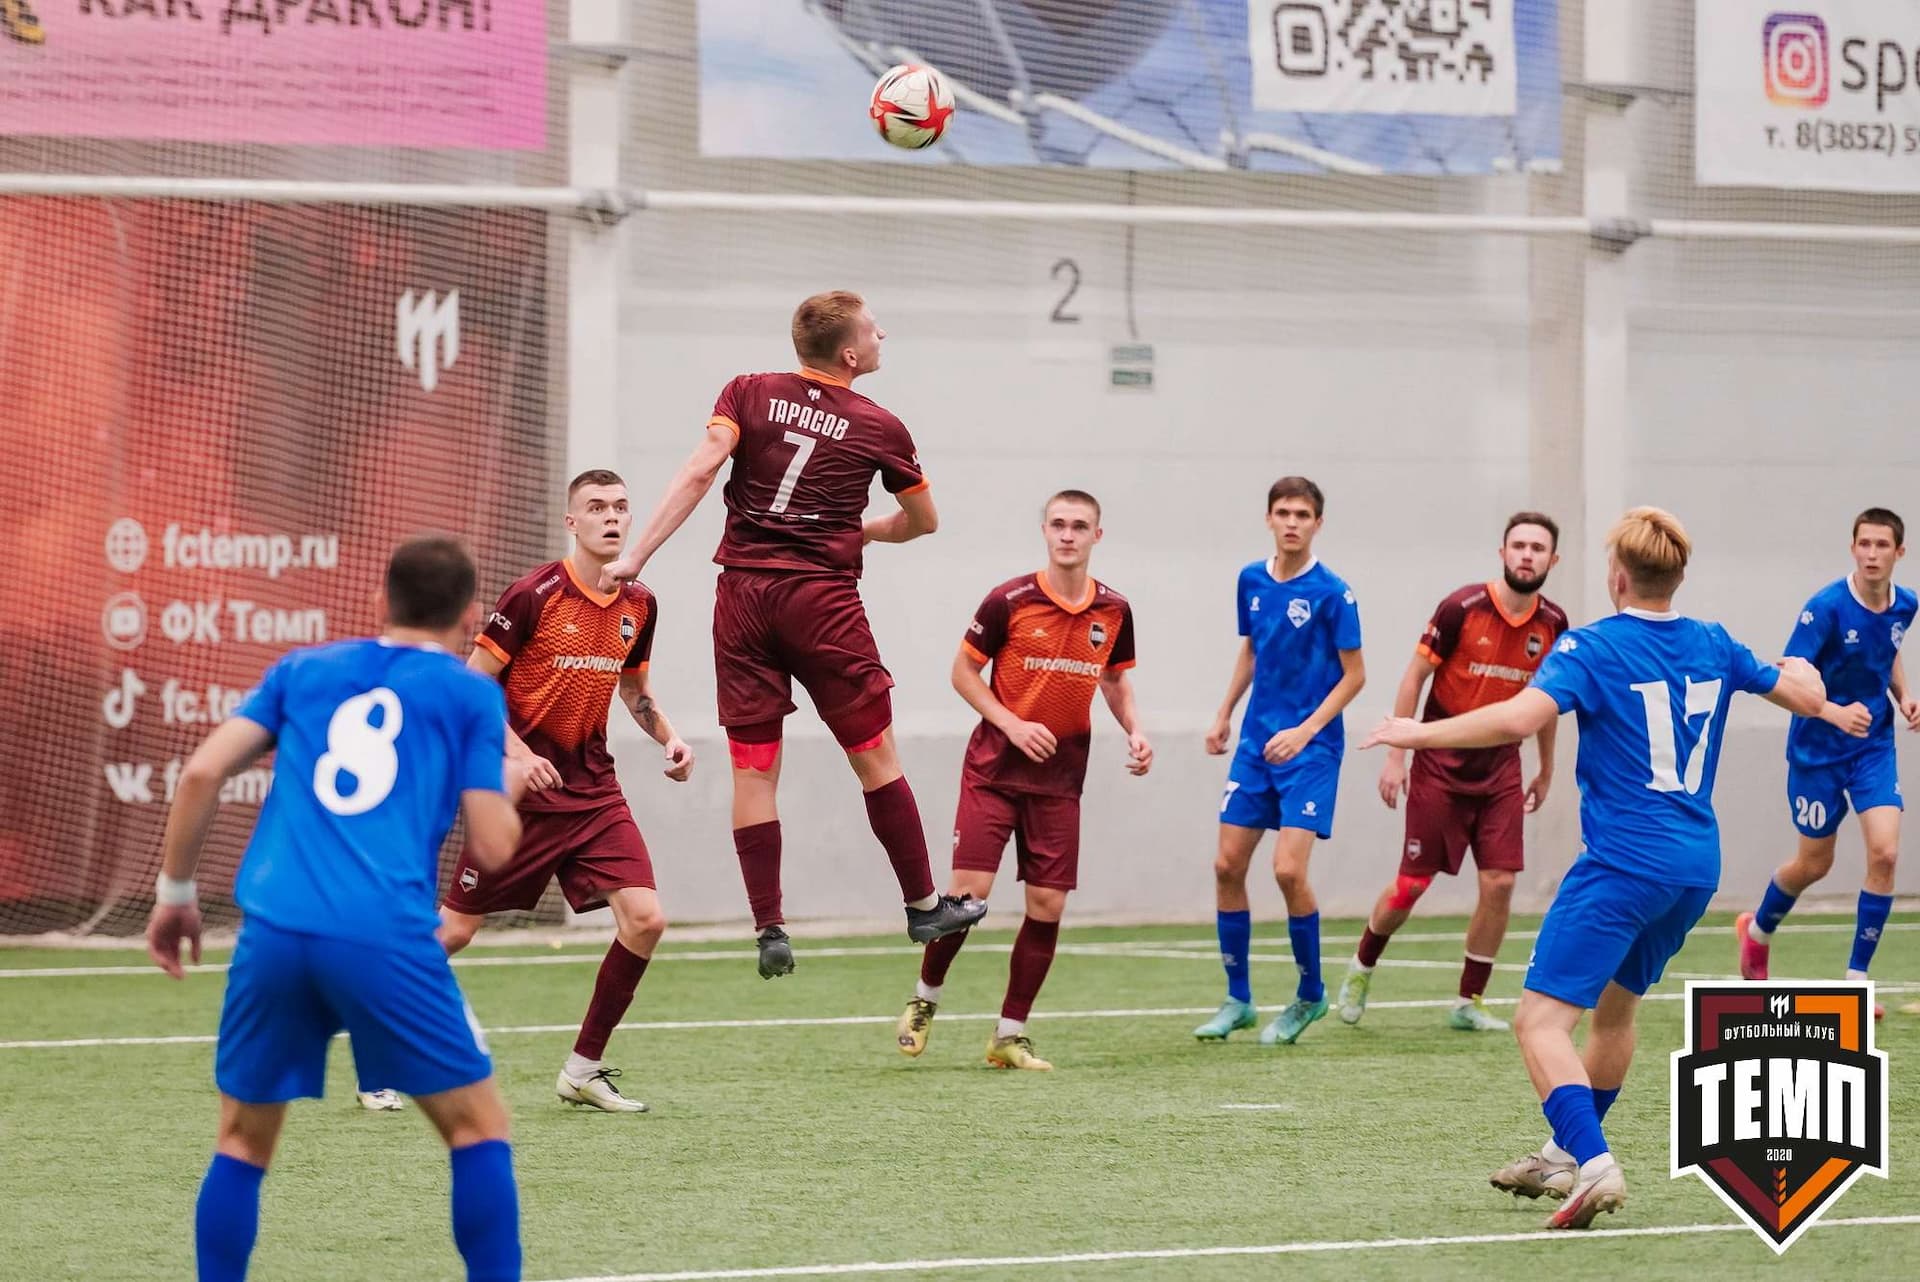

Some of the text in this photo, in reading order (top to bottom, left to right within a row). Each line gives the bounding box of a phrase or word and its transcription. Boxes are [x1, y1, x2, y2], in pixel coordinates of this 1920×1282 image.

[1842, 36, 1920, 112] sp
[1796, 119, 1896, 157] 8(3852)
[1051, 257, 1082, 323] 2
[768, 398, 850, 441] ТАРАСОВ
[768, 430, 818, 513] 7
[162, 522, 340, 578] fctemp.ru
[160, 601, 327, 643] ФК Темп
[313, 686, 404, 816] 8
[1629, 675, 1722, 795] 17
[1795, 795, 1828, 830] 20
